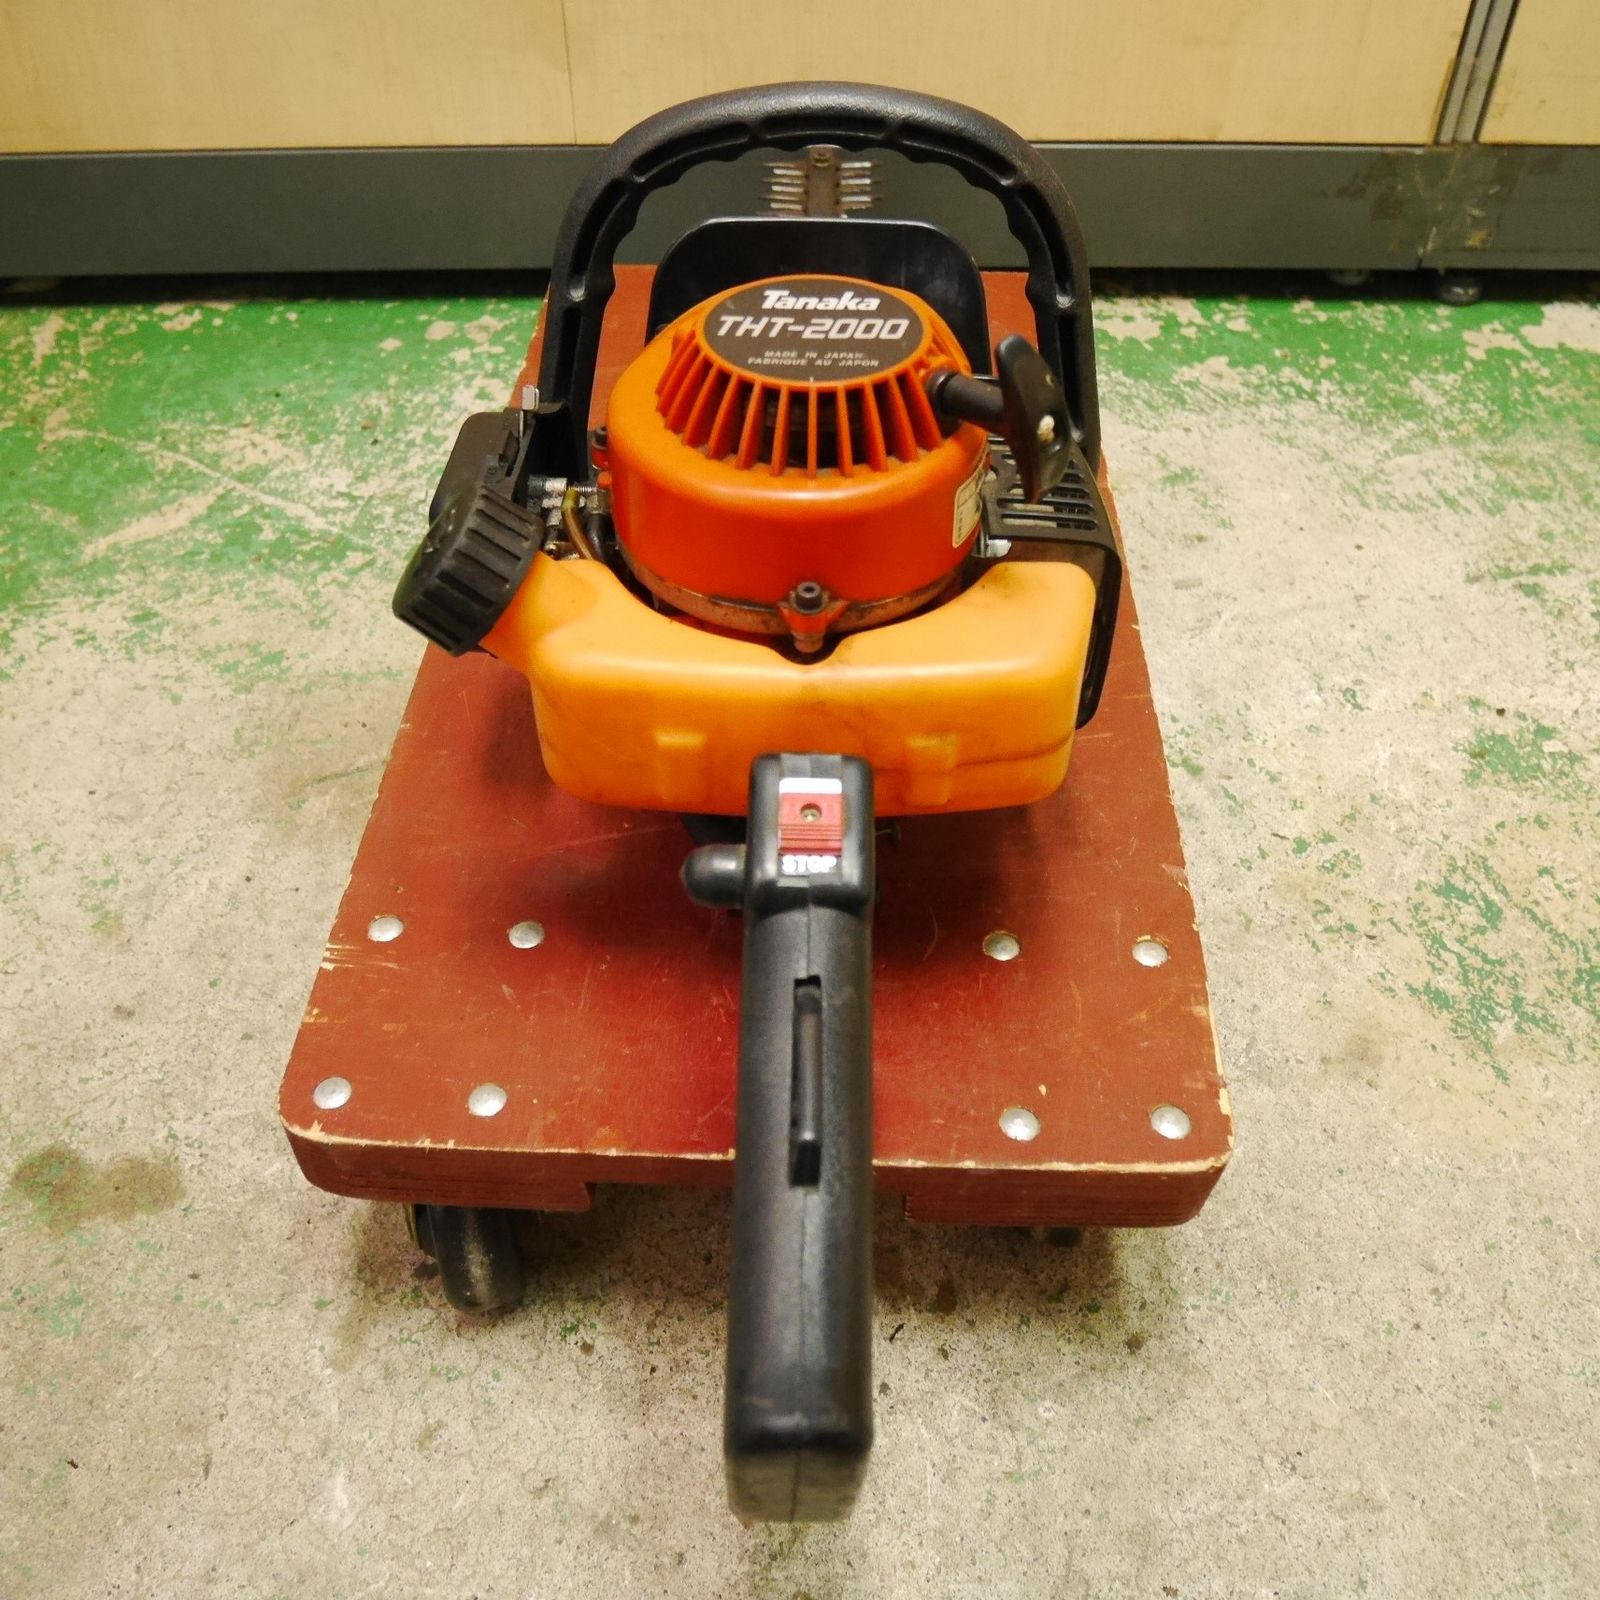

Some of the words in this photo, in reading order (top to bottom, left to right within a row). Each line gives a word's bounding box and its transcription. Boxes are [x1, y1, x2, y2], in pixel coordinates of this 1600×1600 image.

[762, 289, 880, 311] Tanaka
[717, 315, 910, 340] THT-2000
[747, 356, 808, 366] FABRIQUE
[838, 359, 879, 367] JAPON
[764, 350, 798, 358] MADE
[805, 351, 818, 359] IN
[782, 855, 837, 874] STOP
